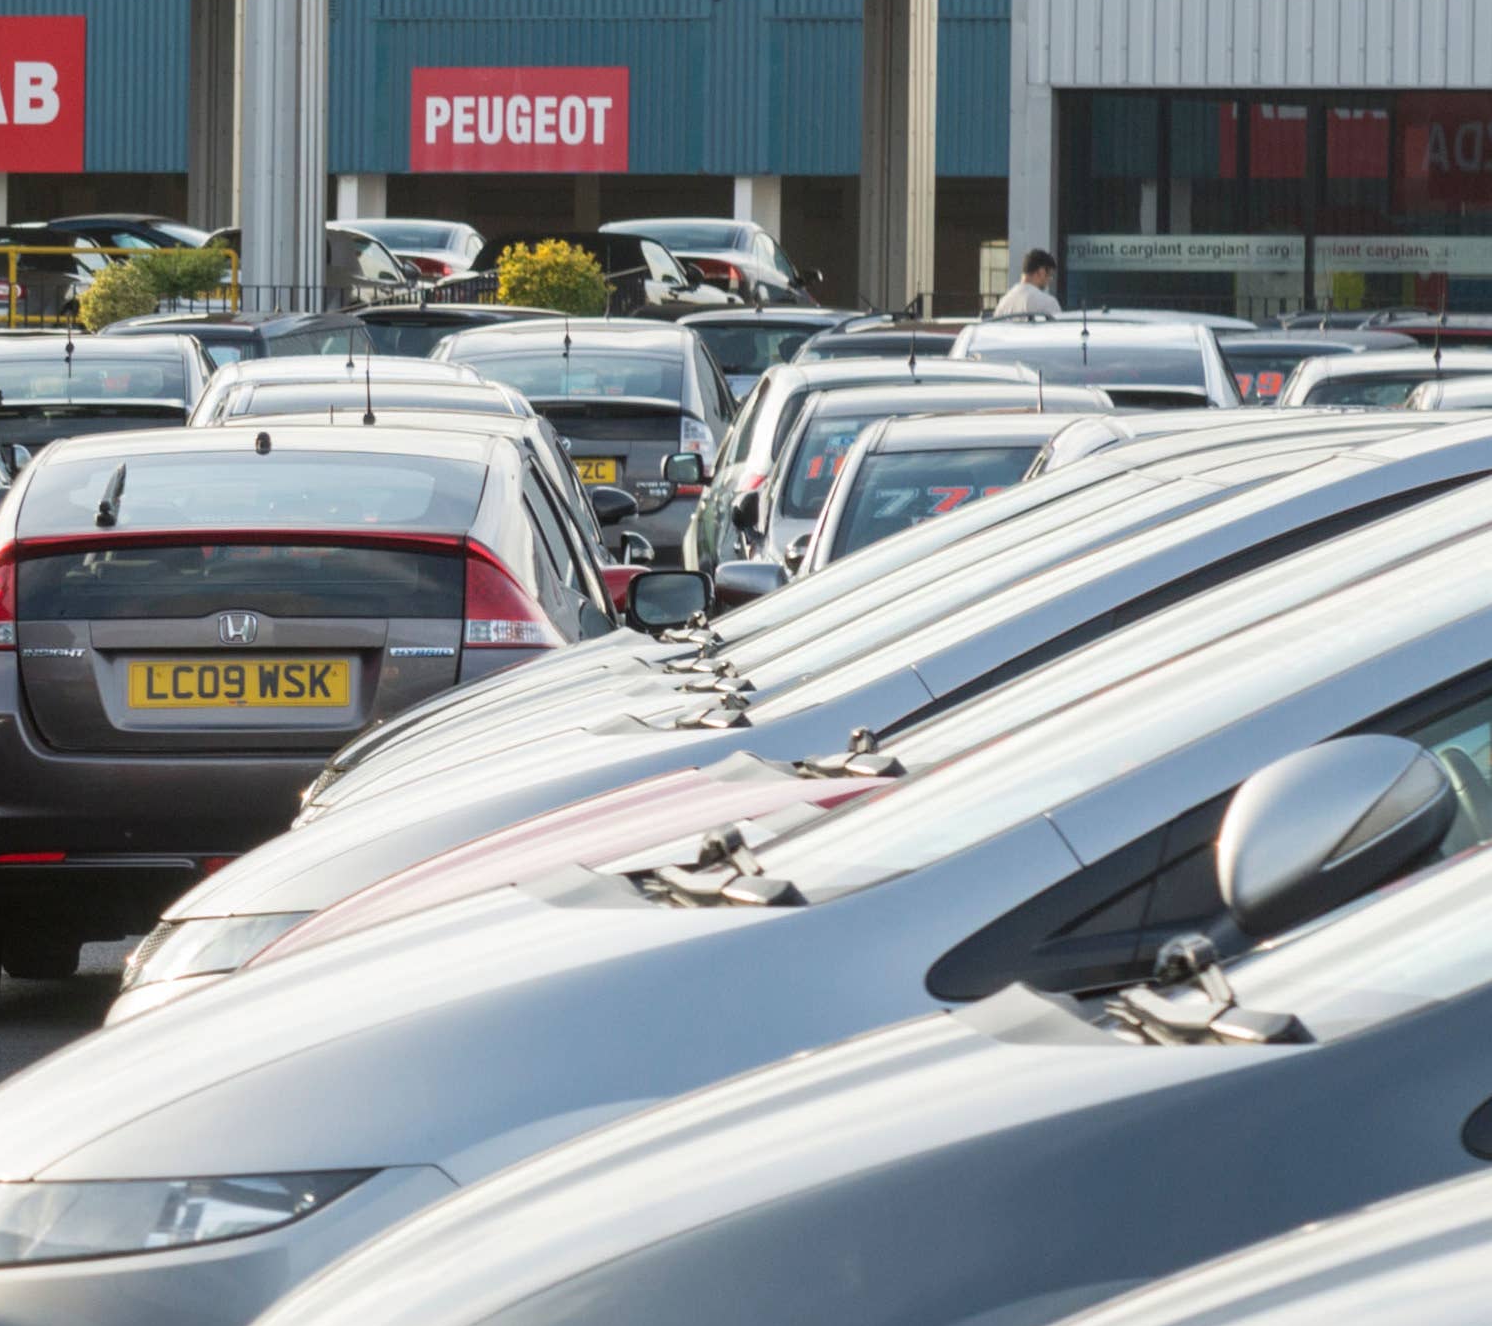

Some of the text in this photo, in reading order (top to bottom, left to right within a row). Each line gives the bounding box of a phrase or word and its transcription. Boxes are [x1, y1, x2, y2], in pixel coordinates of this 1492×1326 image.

[425, 95, 612, 146] PEUGEOT
[145, 664, 333, 700] LC09 WSK
